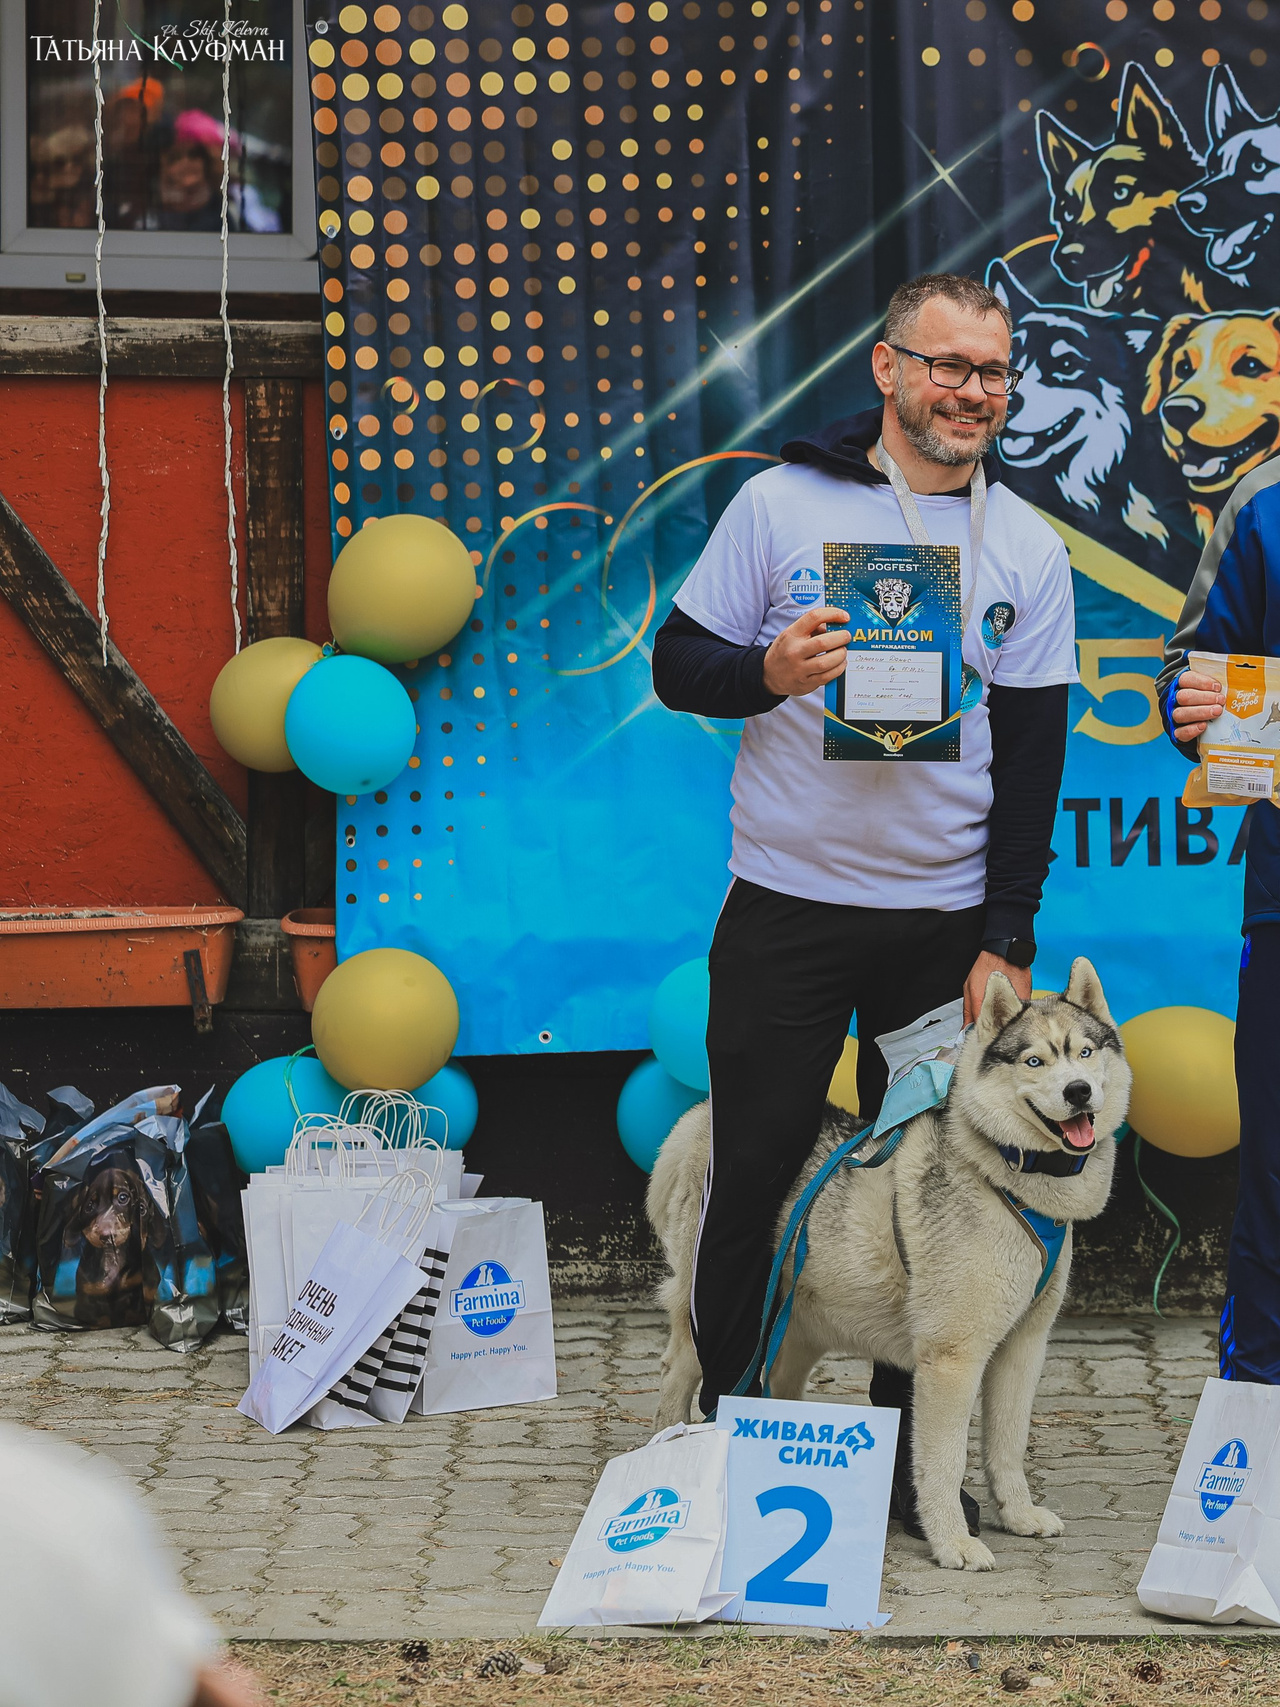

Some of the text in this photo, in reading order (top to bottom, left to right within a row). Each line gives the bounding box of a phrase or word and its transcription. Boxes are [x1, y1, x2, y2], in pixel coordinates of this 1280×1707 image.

[867, 563, 920, 572] DOGFEST
[853, 629, 933, 642] ДИПЛОМ
[888, 734, 899, 745] V
[298, 1279, 338, 1318] ОЧЕНЬ
[455, 1288, 520, 1313] Farmina
[472, 1315, 507, 1328] Pet Foods
[451, 1344, 528, 1361] Happy pet. Happy You.
[731, 1417, 834, 1444] ЖИВАЯ
[778, 1445, 849, 1468] СИЛА
[1199, 1467, 1245, 1493] Farmina
[1204, 1498, 1214, 1509] Pet
[604, 1509, 681, 1537] Farmina
[614, 1531, 655, 1547] Pet Foods
[1178, 1530, 1196, 1543] Happy
[745, 1485, 833, 1607] 2
[583, 1561, 676, 1580] Happy pet. Happy You.
